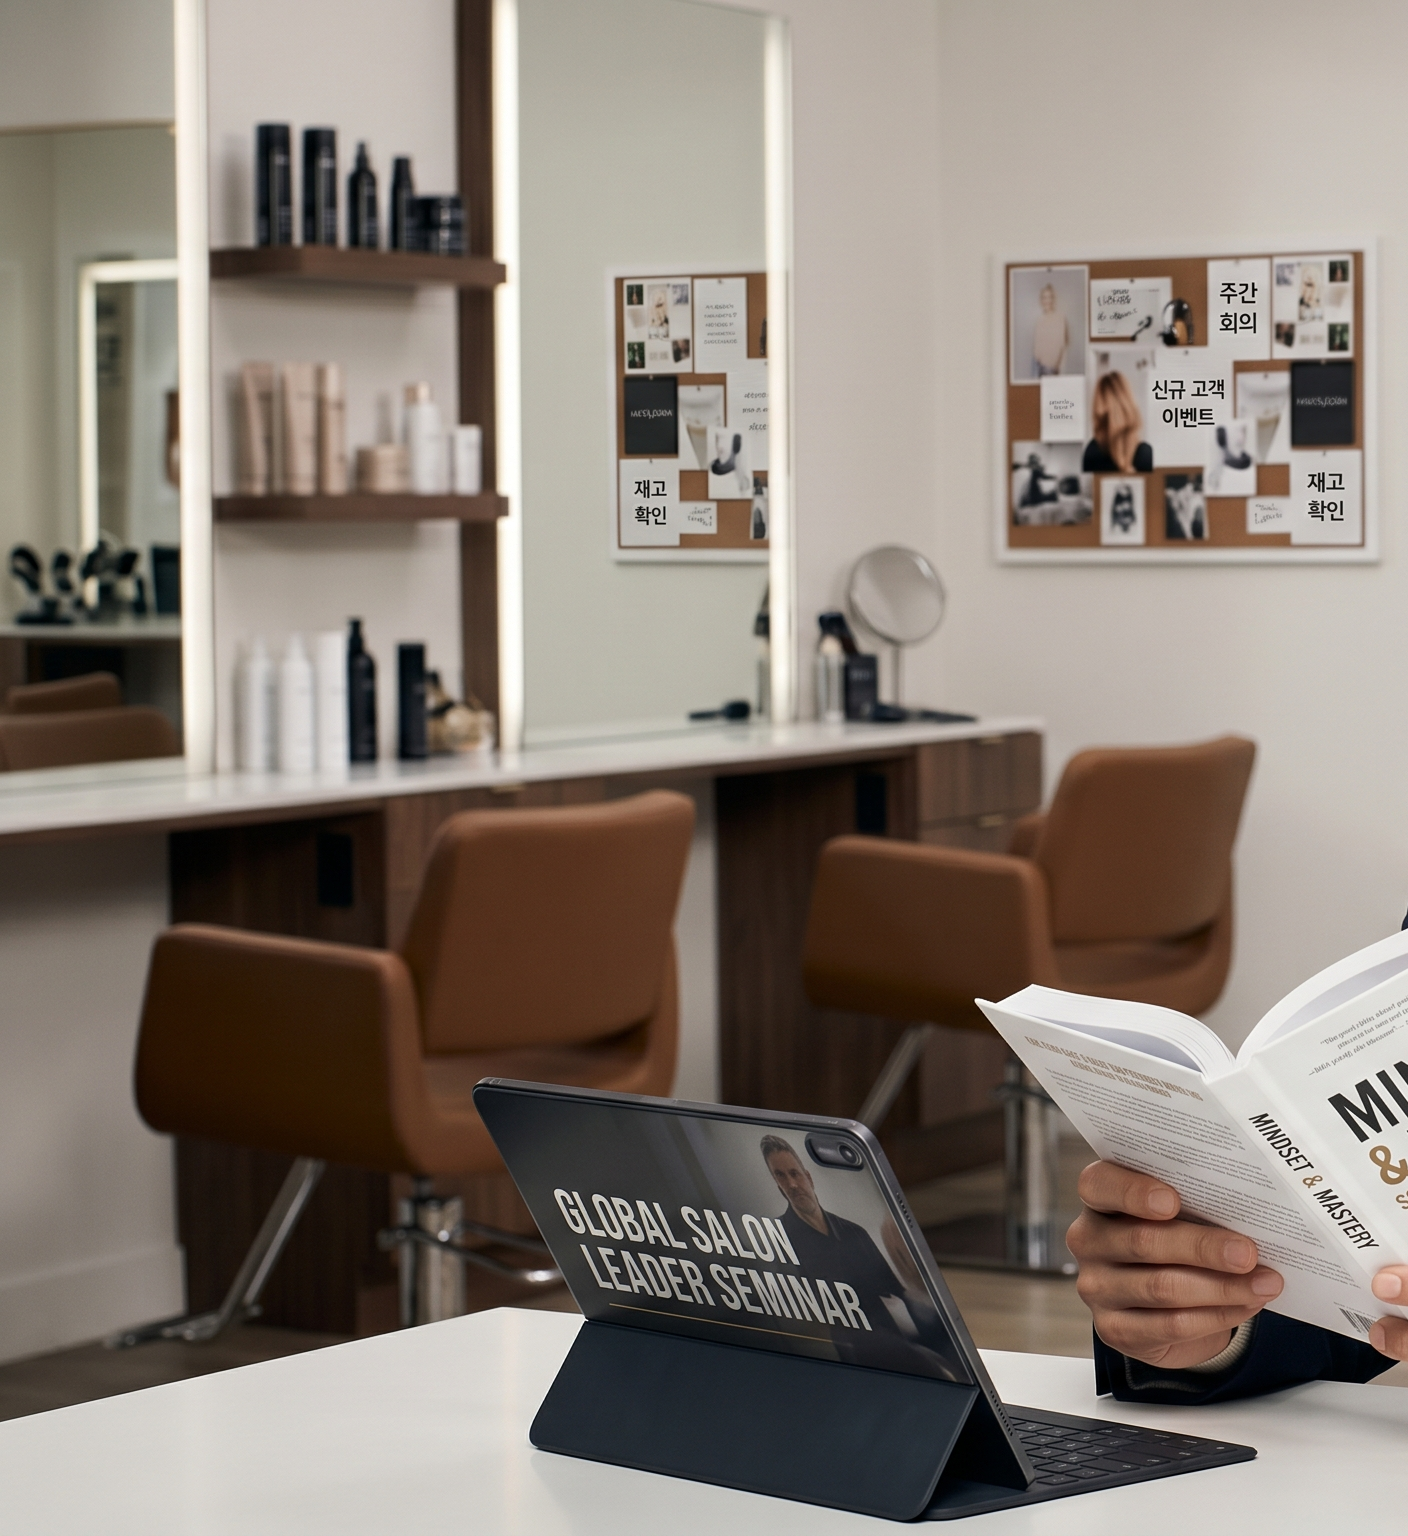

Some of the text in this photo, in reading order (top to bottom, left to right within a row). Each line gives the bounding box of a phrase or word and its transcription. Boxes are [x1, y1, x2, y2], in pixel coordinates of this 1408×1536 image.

[1219, 281, 1258, 305] 주간
[1219, 312, 1258, 335] 회의
[1151, 379, 1225, 401] 신규 고객
[1162, 407, 1215, 428] 이벤트
[634, 479, 667, 499] 재고
[1307, 472, 1345, 493] 재고
[634, 505, 667, 526] 확인
[1308, 500, 1344, 522] 확인
[1248, 1113, 1315, 1172] MINDSET
[1302, 1175, 1323, 1189] &
[1313, 1188, 1380, 1249] MASTERY
[553, 1188, 800, 1266] GLOBAL SALON
[579, 1243, 873, 1331] LEADER SEMINAR
